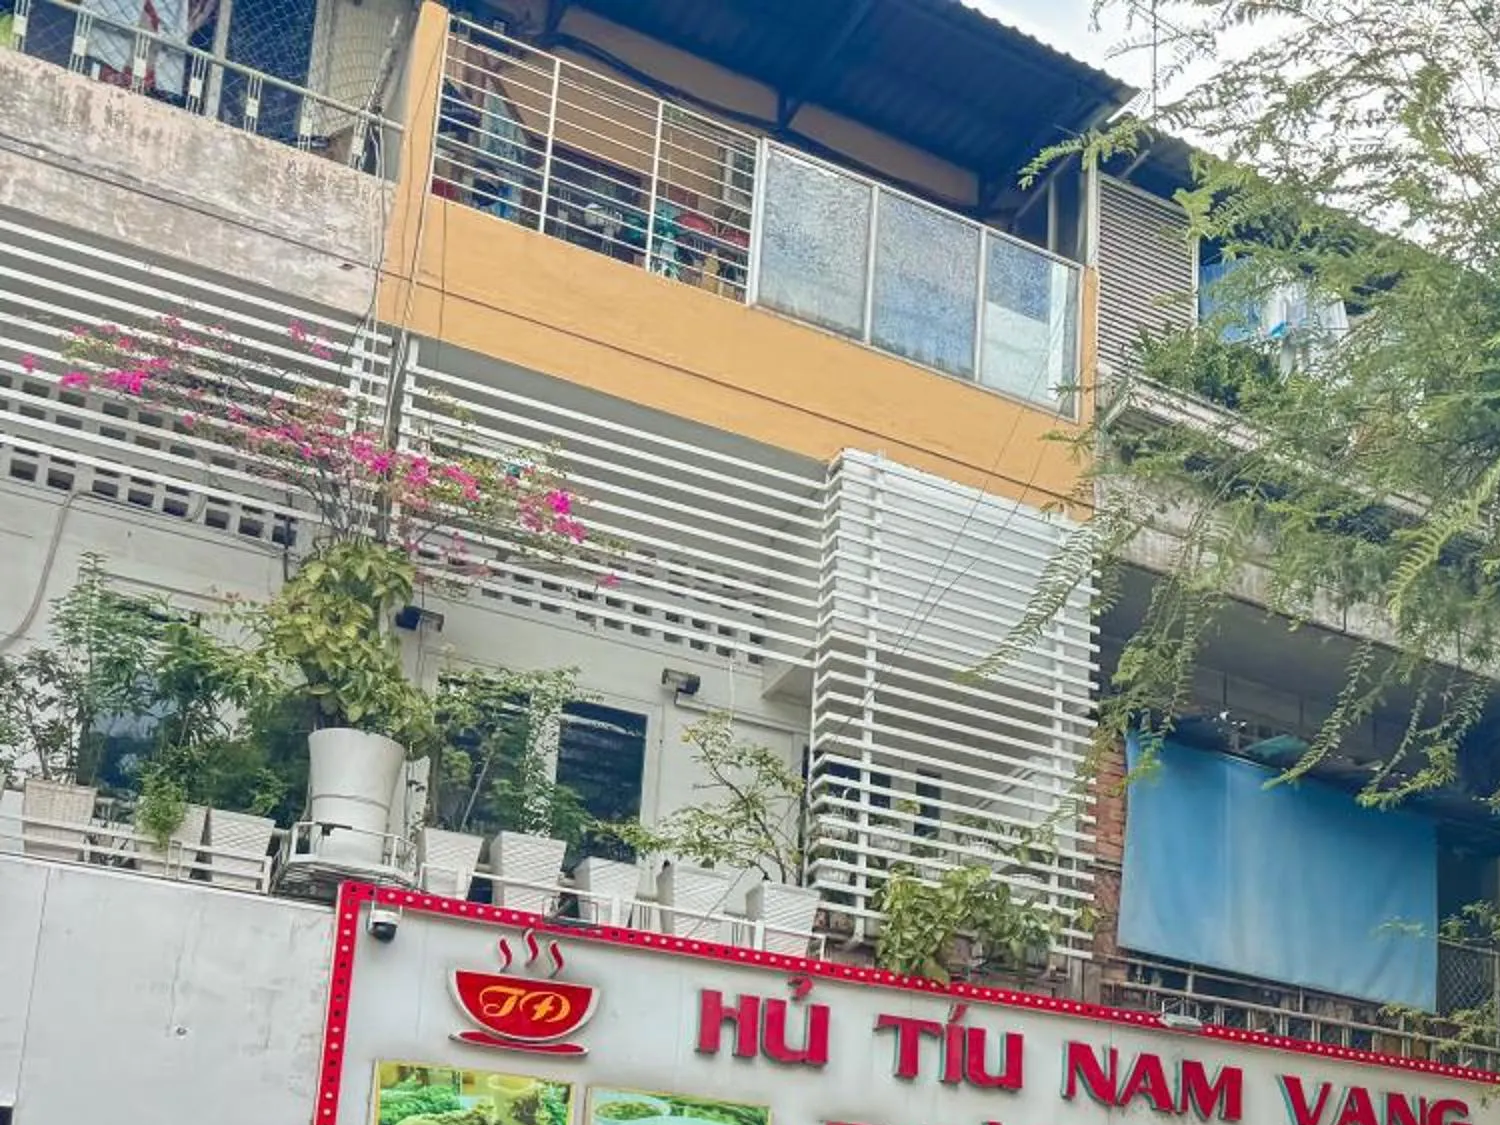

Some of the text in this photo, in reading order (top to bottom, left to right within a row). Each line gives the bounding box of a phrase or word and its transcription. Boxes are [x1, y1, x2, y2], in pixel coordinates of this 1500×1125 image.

[696, 975, 830, 1066] HỦ
[874, 1002, 1024, 1092] TÍU
[1061, 1039, 1243, 1122] NAM
